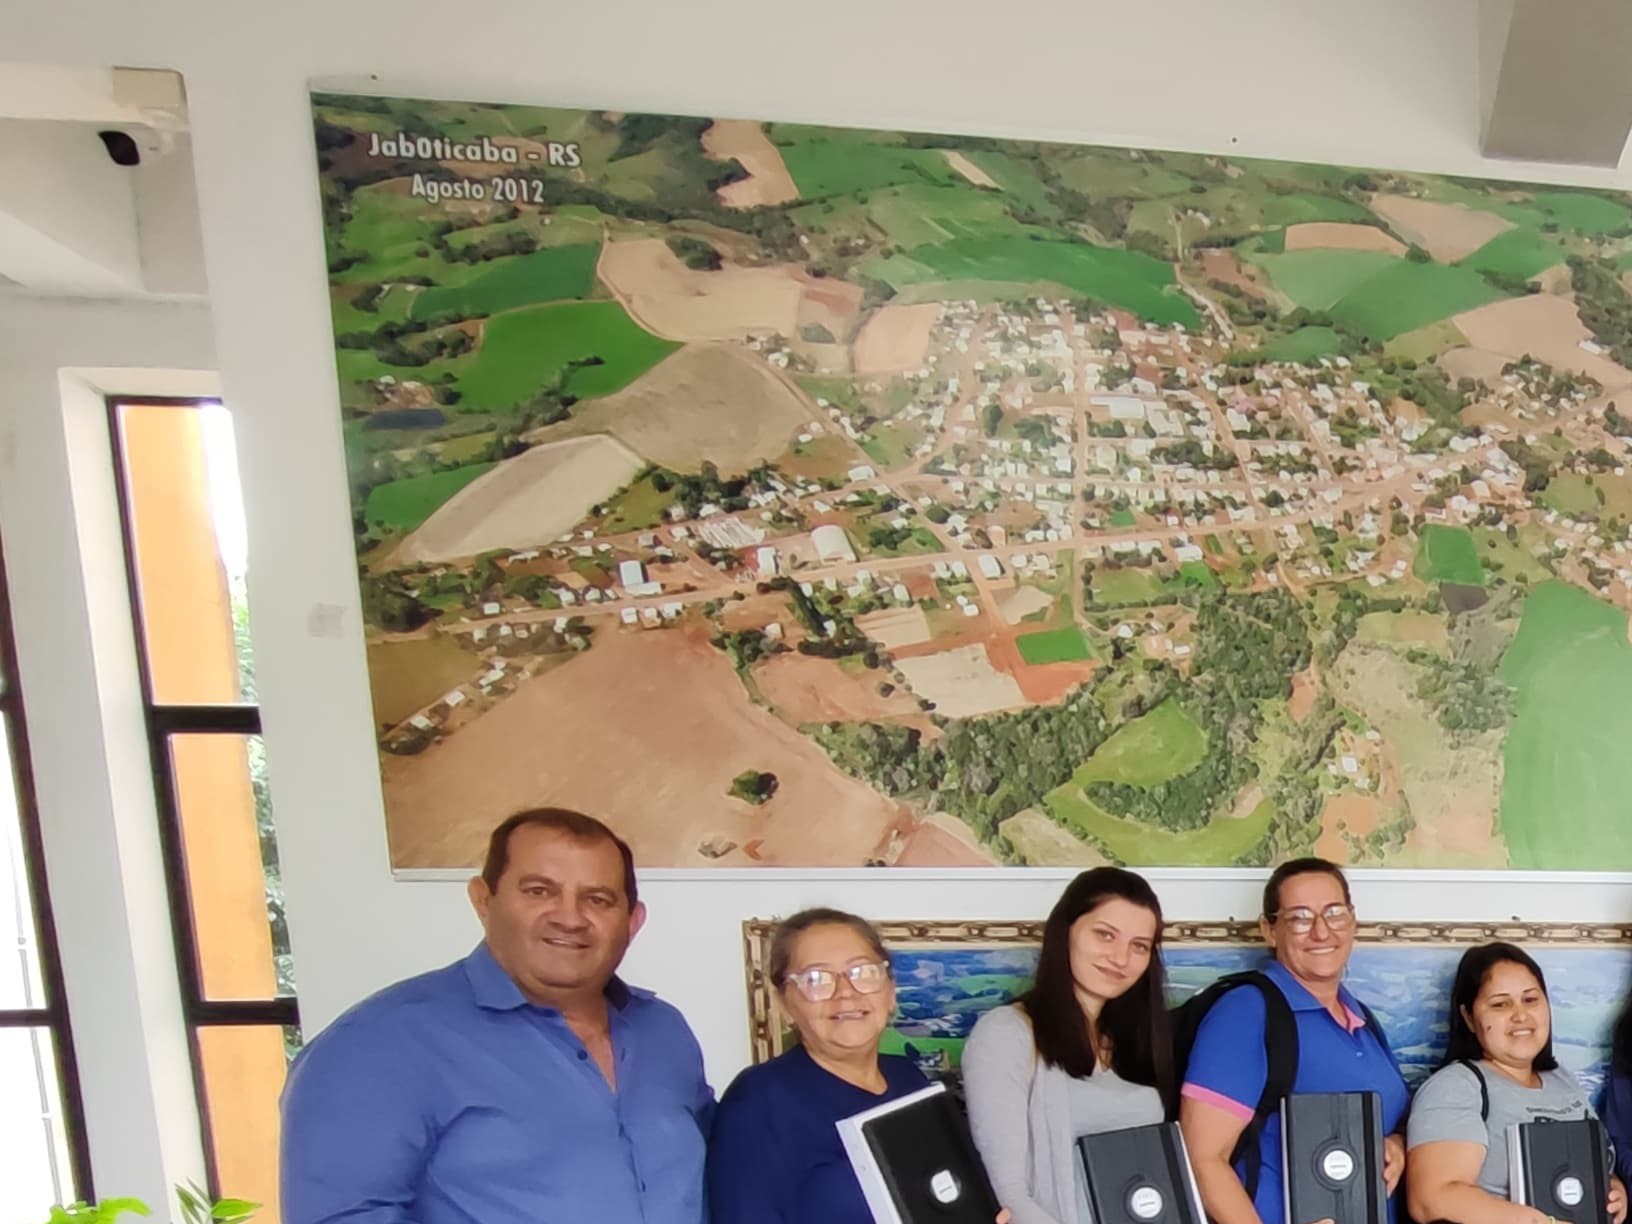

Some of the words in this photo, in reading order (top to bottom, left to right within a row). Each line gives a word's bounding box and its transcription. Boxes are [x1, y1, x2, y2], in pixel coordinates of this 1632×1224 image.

[550, 143, 580, 167] RS
[412, 173, 484, 203] Agosto
[491, 178, 544, 202] 2012
